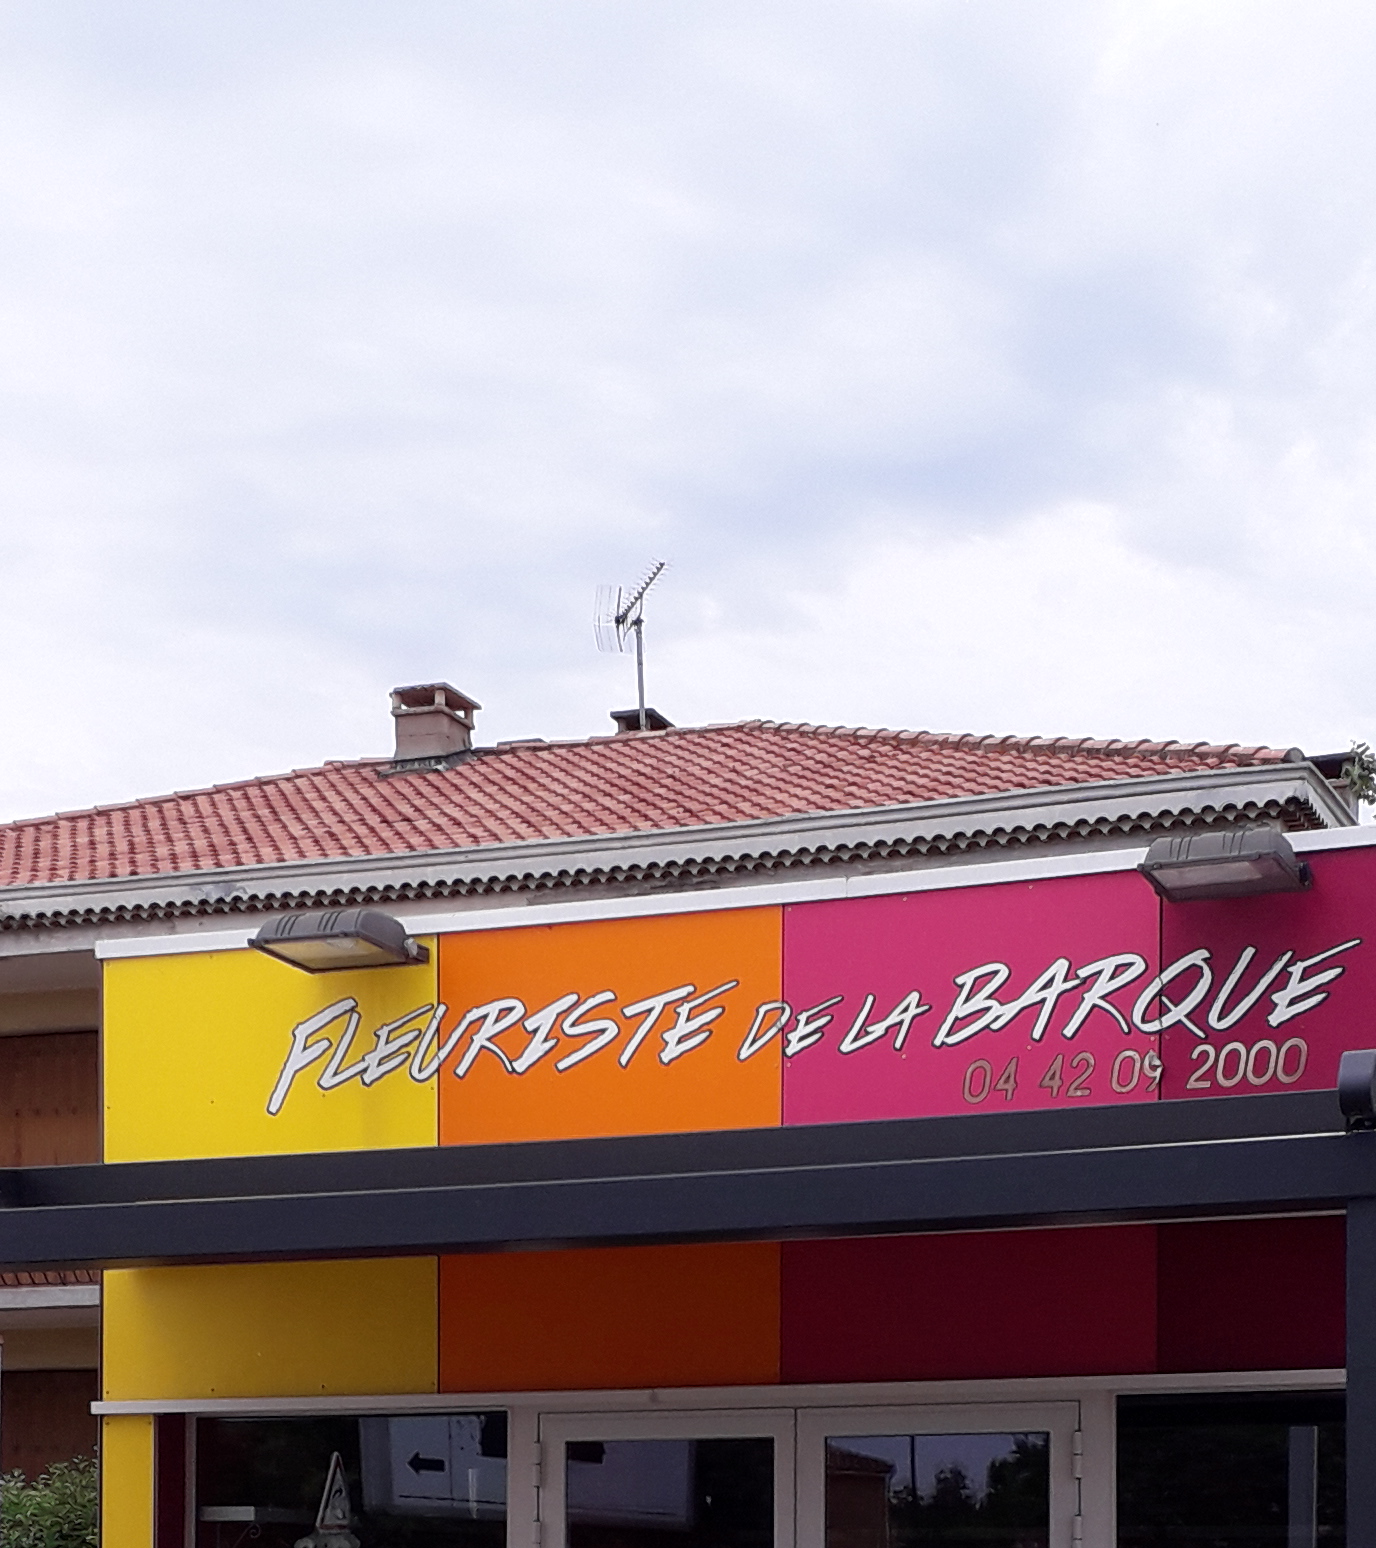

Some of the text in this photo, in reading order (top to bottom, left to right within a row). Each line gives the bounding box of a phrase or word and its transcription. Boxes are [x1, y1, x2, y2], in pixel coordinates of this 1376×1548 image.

[266, 938, 1363, 1116] FLEURISTE DE LA BARQUE
[962, 1036, 1309, 1103] 04 42 09 2000
